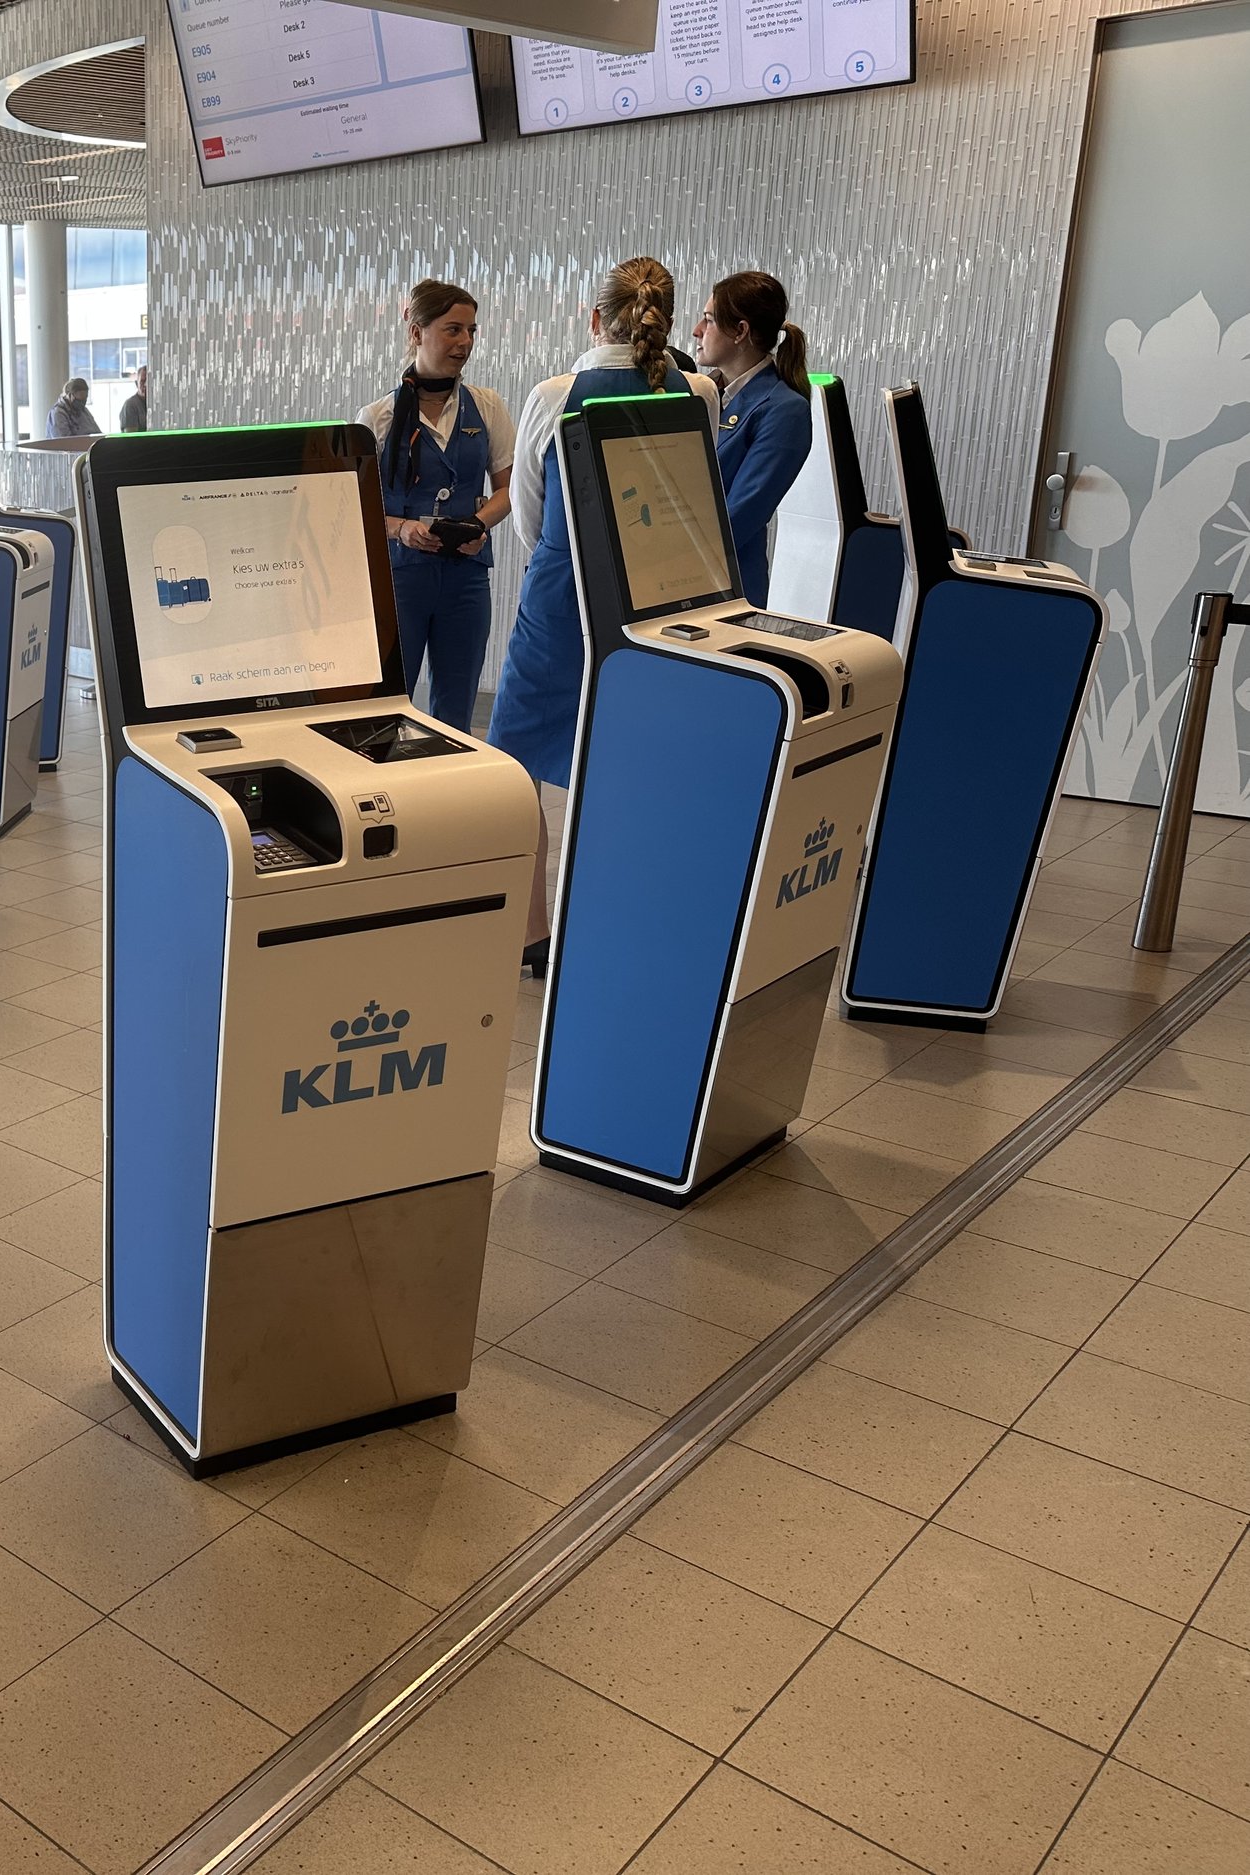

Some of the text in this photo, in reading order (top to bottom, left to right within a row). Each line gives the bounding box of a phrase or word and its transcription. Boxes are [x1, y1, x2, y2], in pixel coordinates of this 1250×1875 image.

[187, 16, 230, 32] Queue number
[283, 20, 306, 33] Desk 2
[673, 19, 689, 27] queue
[704, 22, 719, 30] paper
[753, 29, 777, 37] assigned
[192, 44, 212, 58] E905
[288, 50, 311, 63] Desk 5
[855, 61, 864, 73] 5
[197, 70, 217, 84] E904
[293, 77, 315, 89] Desk 3
[772, 74, 781, 85] 4
[694, 85, 702, 96] 3
[201, 95, 221, 109] E899
[621, 96, 629, 107] 2
[300, 107, 322, 116] Estimated
[323, 104, 339, 112] waiting
[553, 107, 559, 118] 1
[341, 113, 368, 124] General
[225, 134, 257, 146] SkyPriority
[233, 557, 305, 574] Kies uw extra's
[235, 578, 298, 590] Choose your extra's
[21, 642, 41, 671] KLM
[210, 659, 336, 683] Raak scherm aan en begin
[255, 696, 281, 709] SITA
[775, 847, 844, 910] KLM
[281, 1042, 448, 1115] KLM
